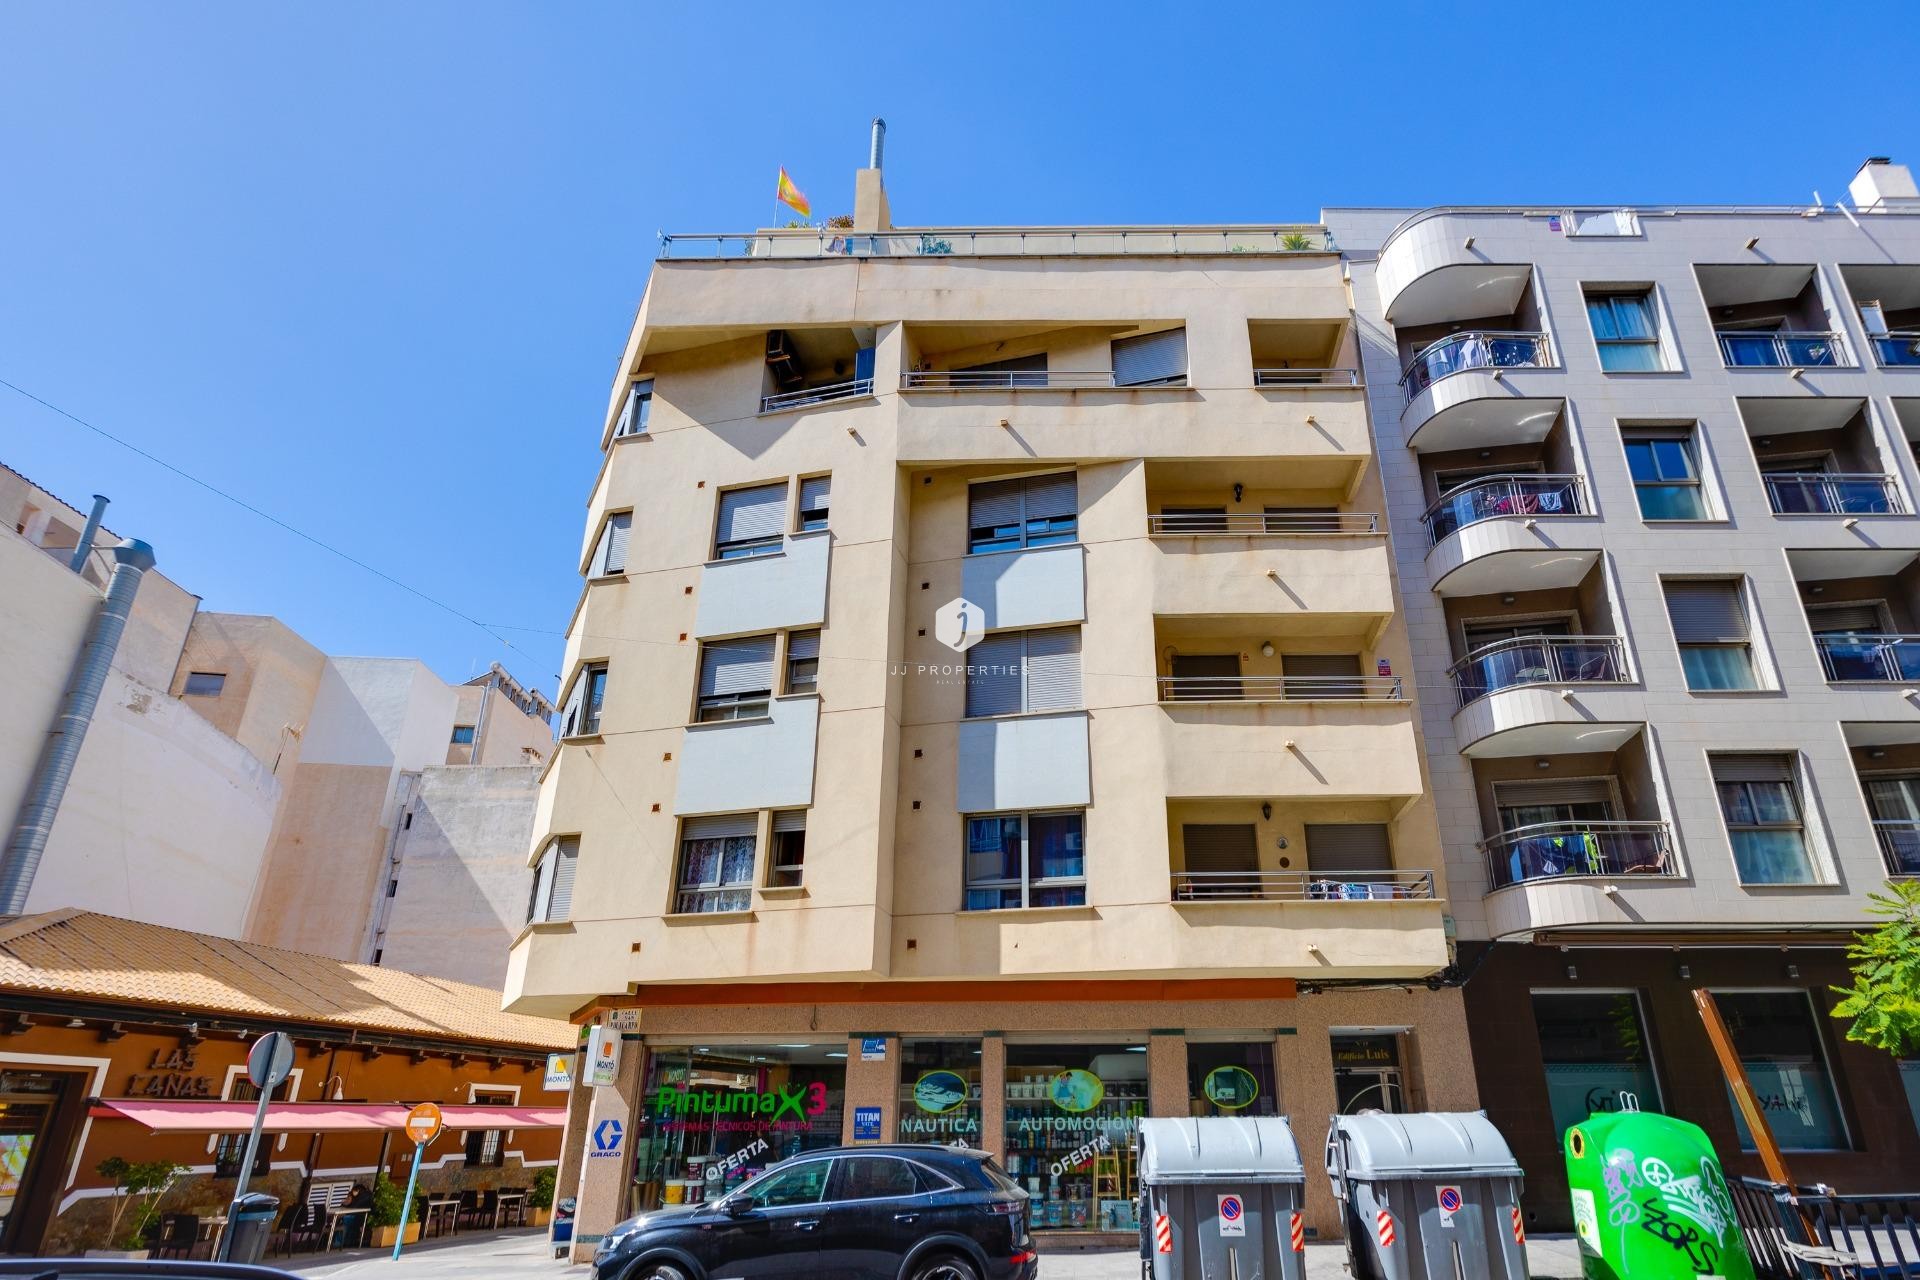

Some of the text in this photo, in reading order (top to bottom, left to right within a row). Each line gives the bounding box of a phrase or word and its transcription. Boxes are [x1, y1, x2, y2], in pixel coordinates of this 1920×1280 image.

[149, 1045, 198, 1070] LAS
[1366, 1047, 1390, 1060] Luis
[855, 1113, 880, 1122] TITAN
[901, 1118, 977, 1133] NAUTICA
[705, 1138, 769, 1181] OFERTA
[1050, 1135, 1110, 1177] OFERTA
